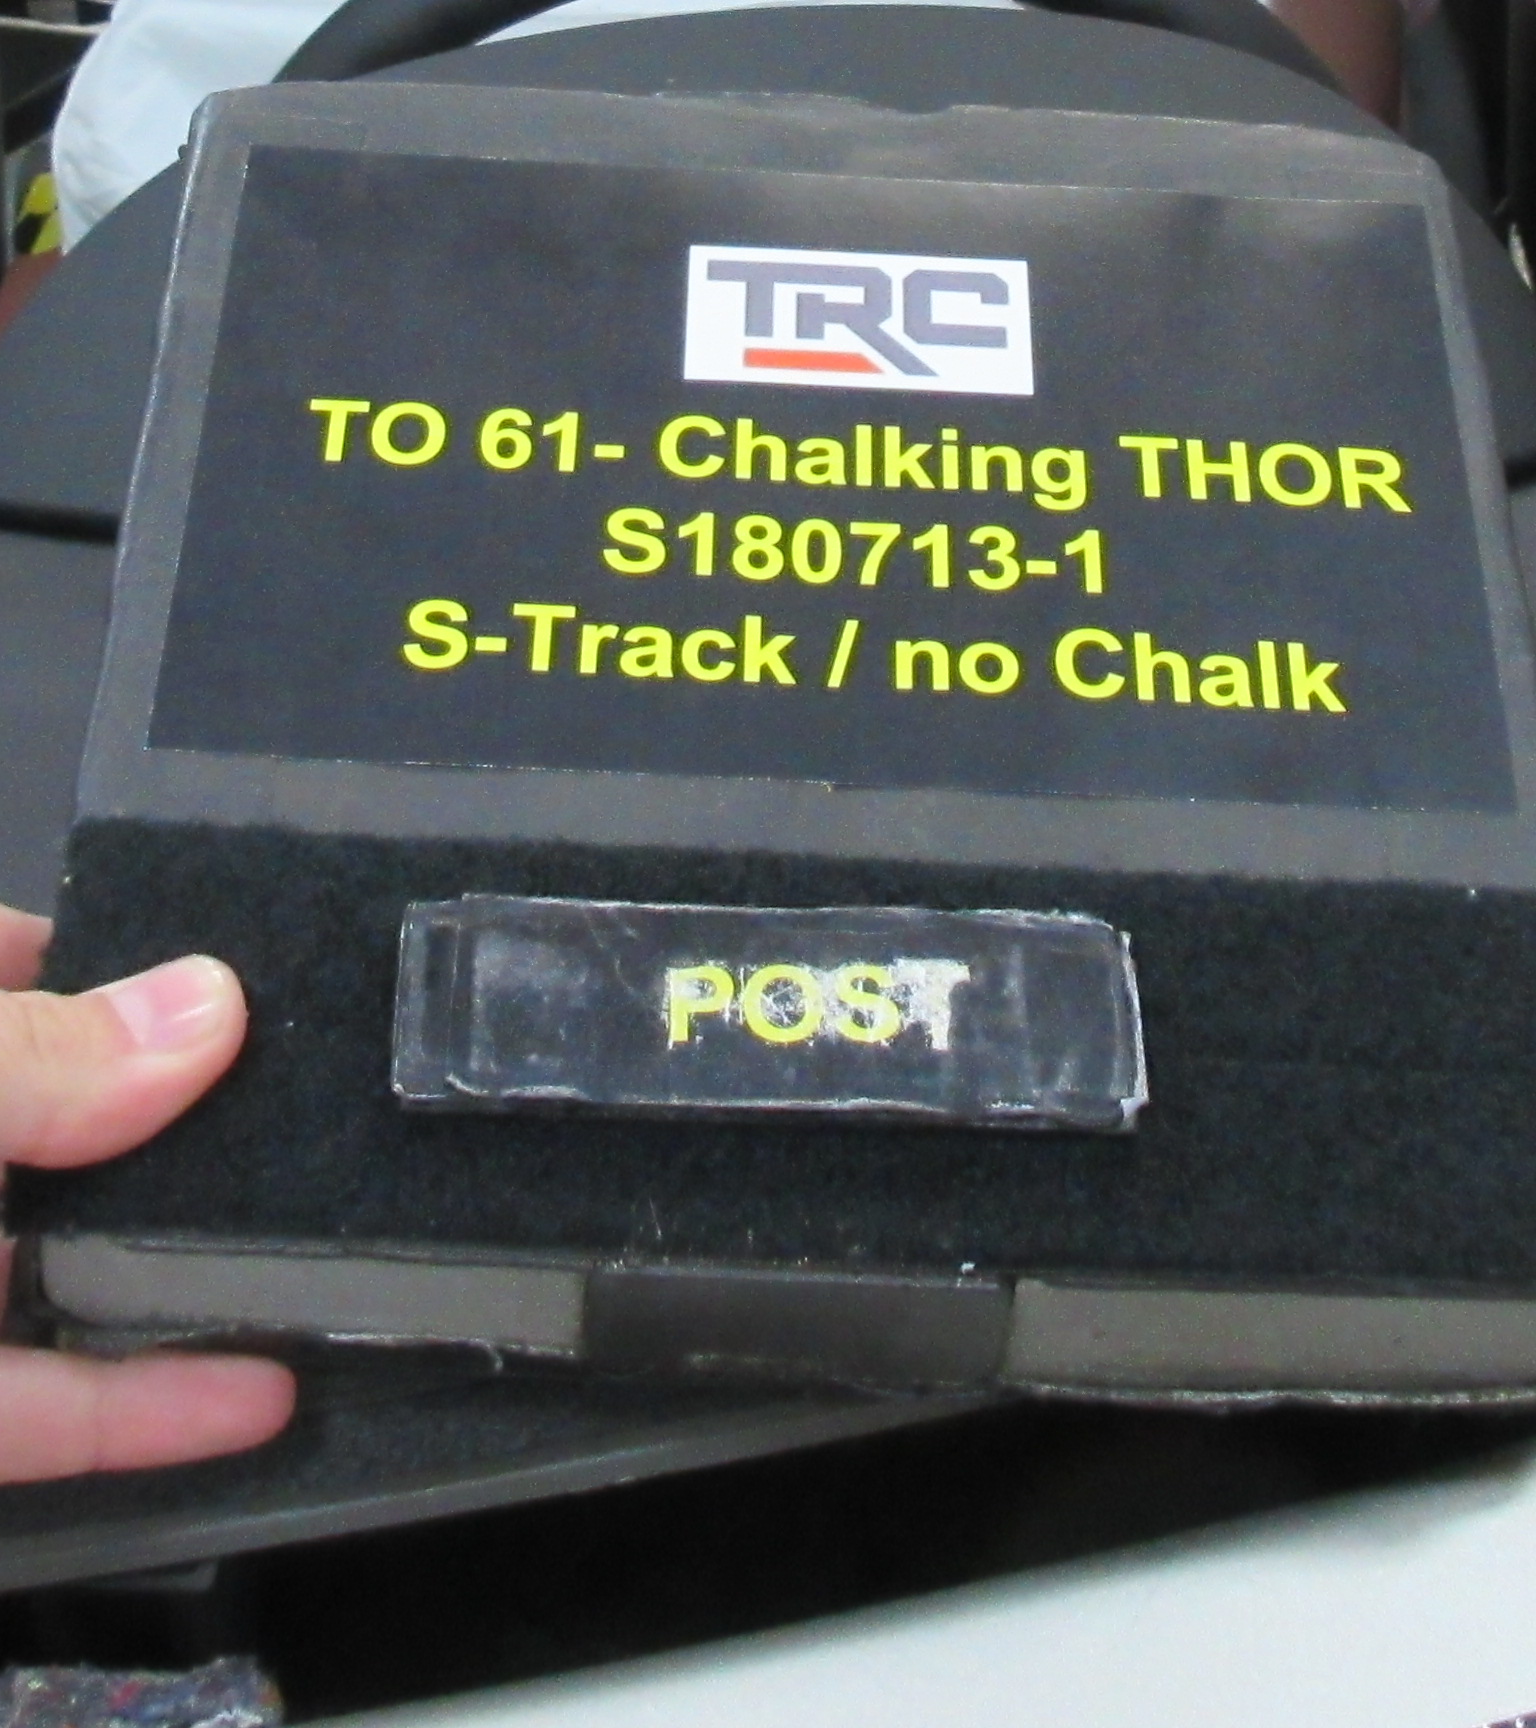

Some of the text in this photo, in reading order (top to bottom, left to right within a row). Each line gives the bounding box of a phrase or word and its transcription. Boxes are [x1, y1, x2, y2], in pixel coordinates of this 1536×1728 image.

[706, 258, 1010, 377] TRC
[306, 396, 1414, 516] TO 61- Chalking THOR
[601, 504, 1106, 596] S180713-1
[399, 596, 1348, 716] S-Track / no Chalk
[666, 958, 971, 1052] POST
